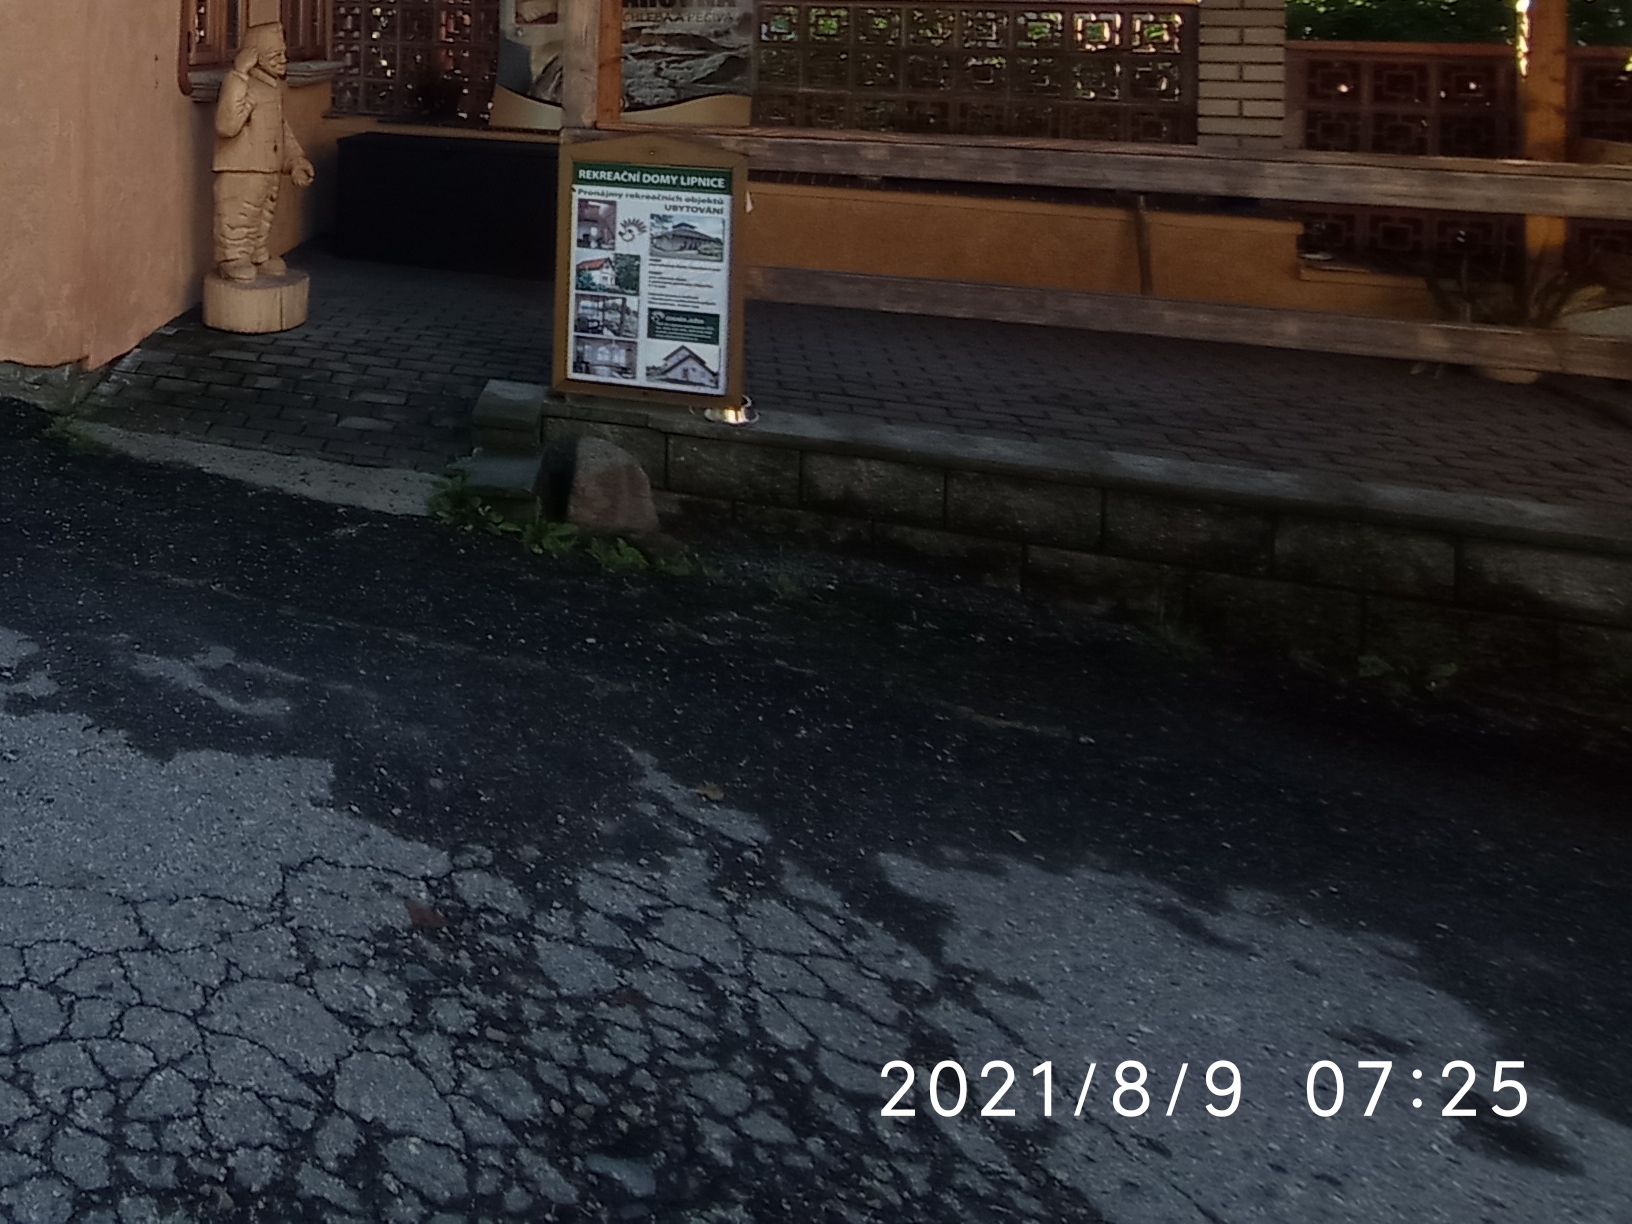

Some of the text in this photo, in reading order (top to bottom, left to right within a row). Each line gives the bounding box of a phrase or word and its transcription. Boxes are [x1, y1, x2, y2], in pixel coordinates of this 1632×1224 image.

[578, 169, 726, 189] REKREAČNÍ DOMY LIPNICE
